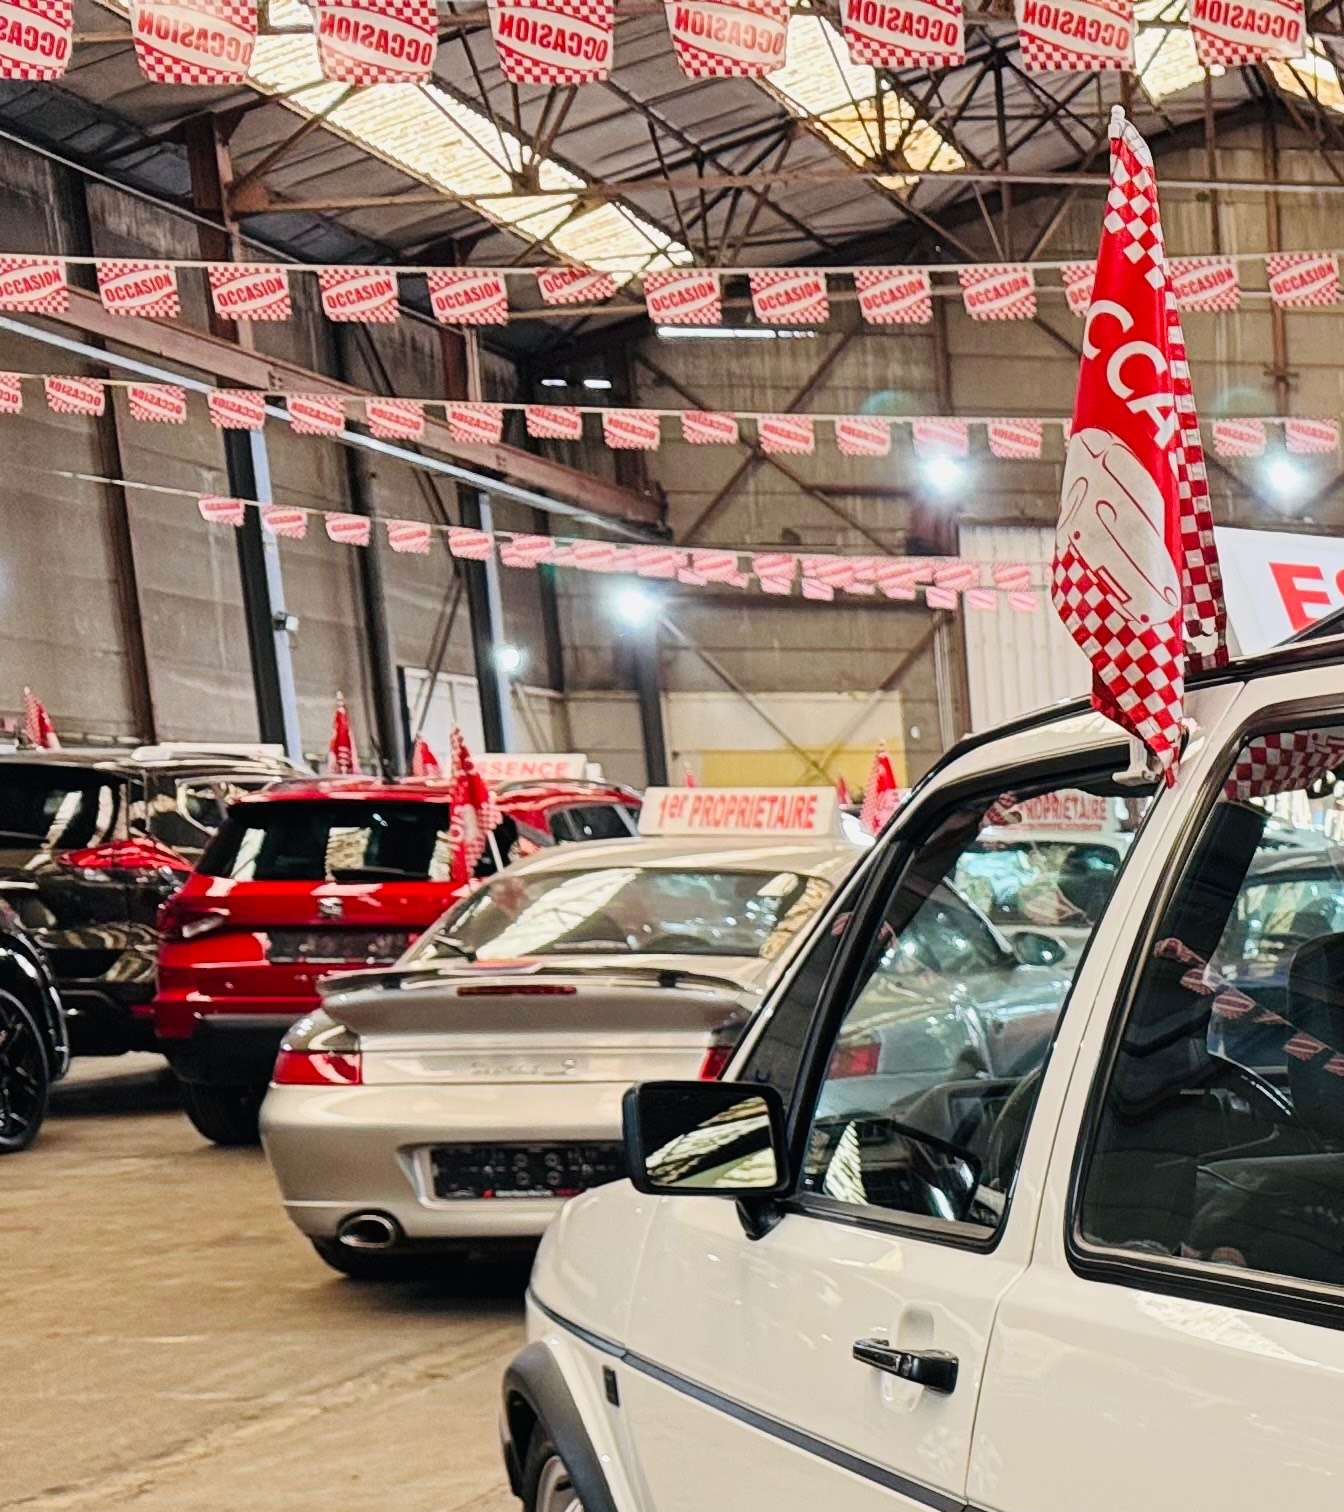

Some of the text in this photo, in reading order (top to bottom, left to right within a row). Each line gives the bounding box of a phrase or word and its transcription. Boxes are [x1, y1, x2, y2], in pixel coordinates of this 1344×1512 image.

[105, 274, 173, 303] OCCASION
[217, 277, 285, 307] OCCASION
[967, 277, 1029, 308] OCCASION
[1275, 261, 1334, 294] OCCASION
[325, 279, 393, 310] OCCASION
[436, 281, 500, 311] OCCASION
[651, 283, 715, 312] OCCASION
[757, 280, 822, 312] OCCASION
[862, 279, 925, 310] OCCASION
[689, 795, 817, 829] PROPRIETAIRE
